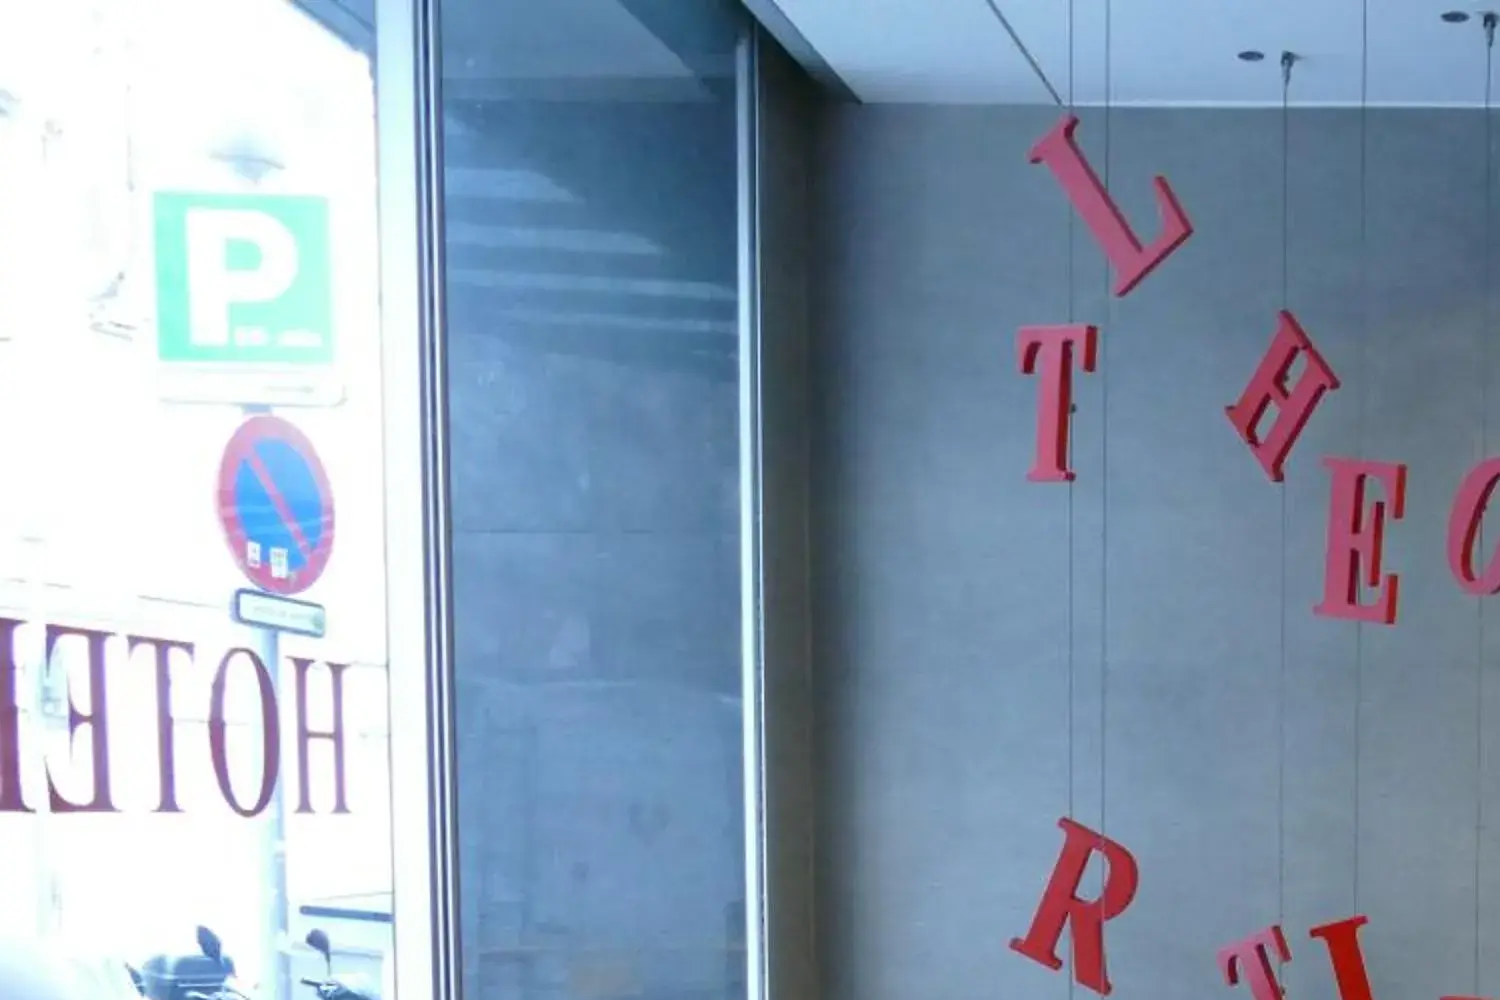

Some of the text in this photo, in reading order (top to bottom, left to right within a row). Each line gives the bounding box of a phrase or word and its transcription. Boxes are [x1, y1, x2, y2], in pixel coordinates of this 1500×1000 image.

[186, 206, 298, 346] P
[1027, 114, 1194, 297] L
[1016, 324, 1097, 482] T
[1009, 816, 1139, 996] R
